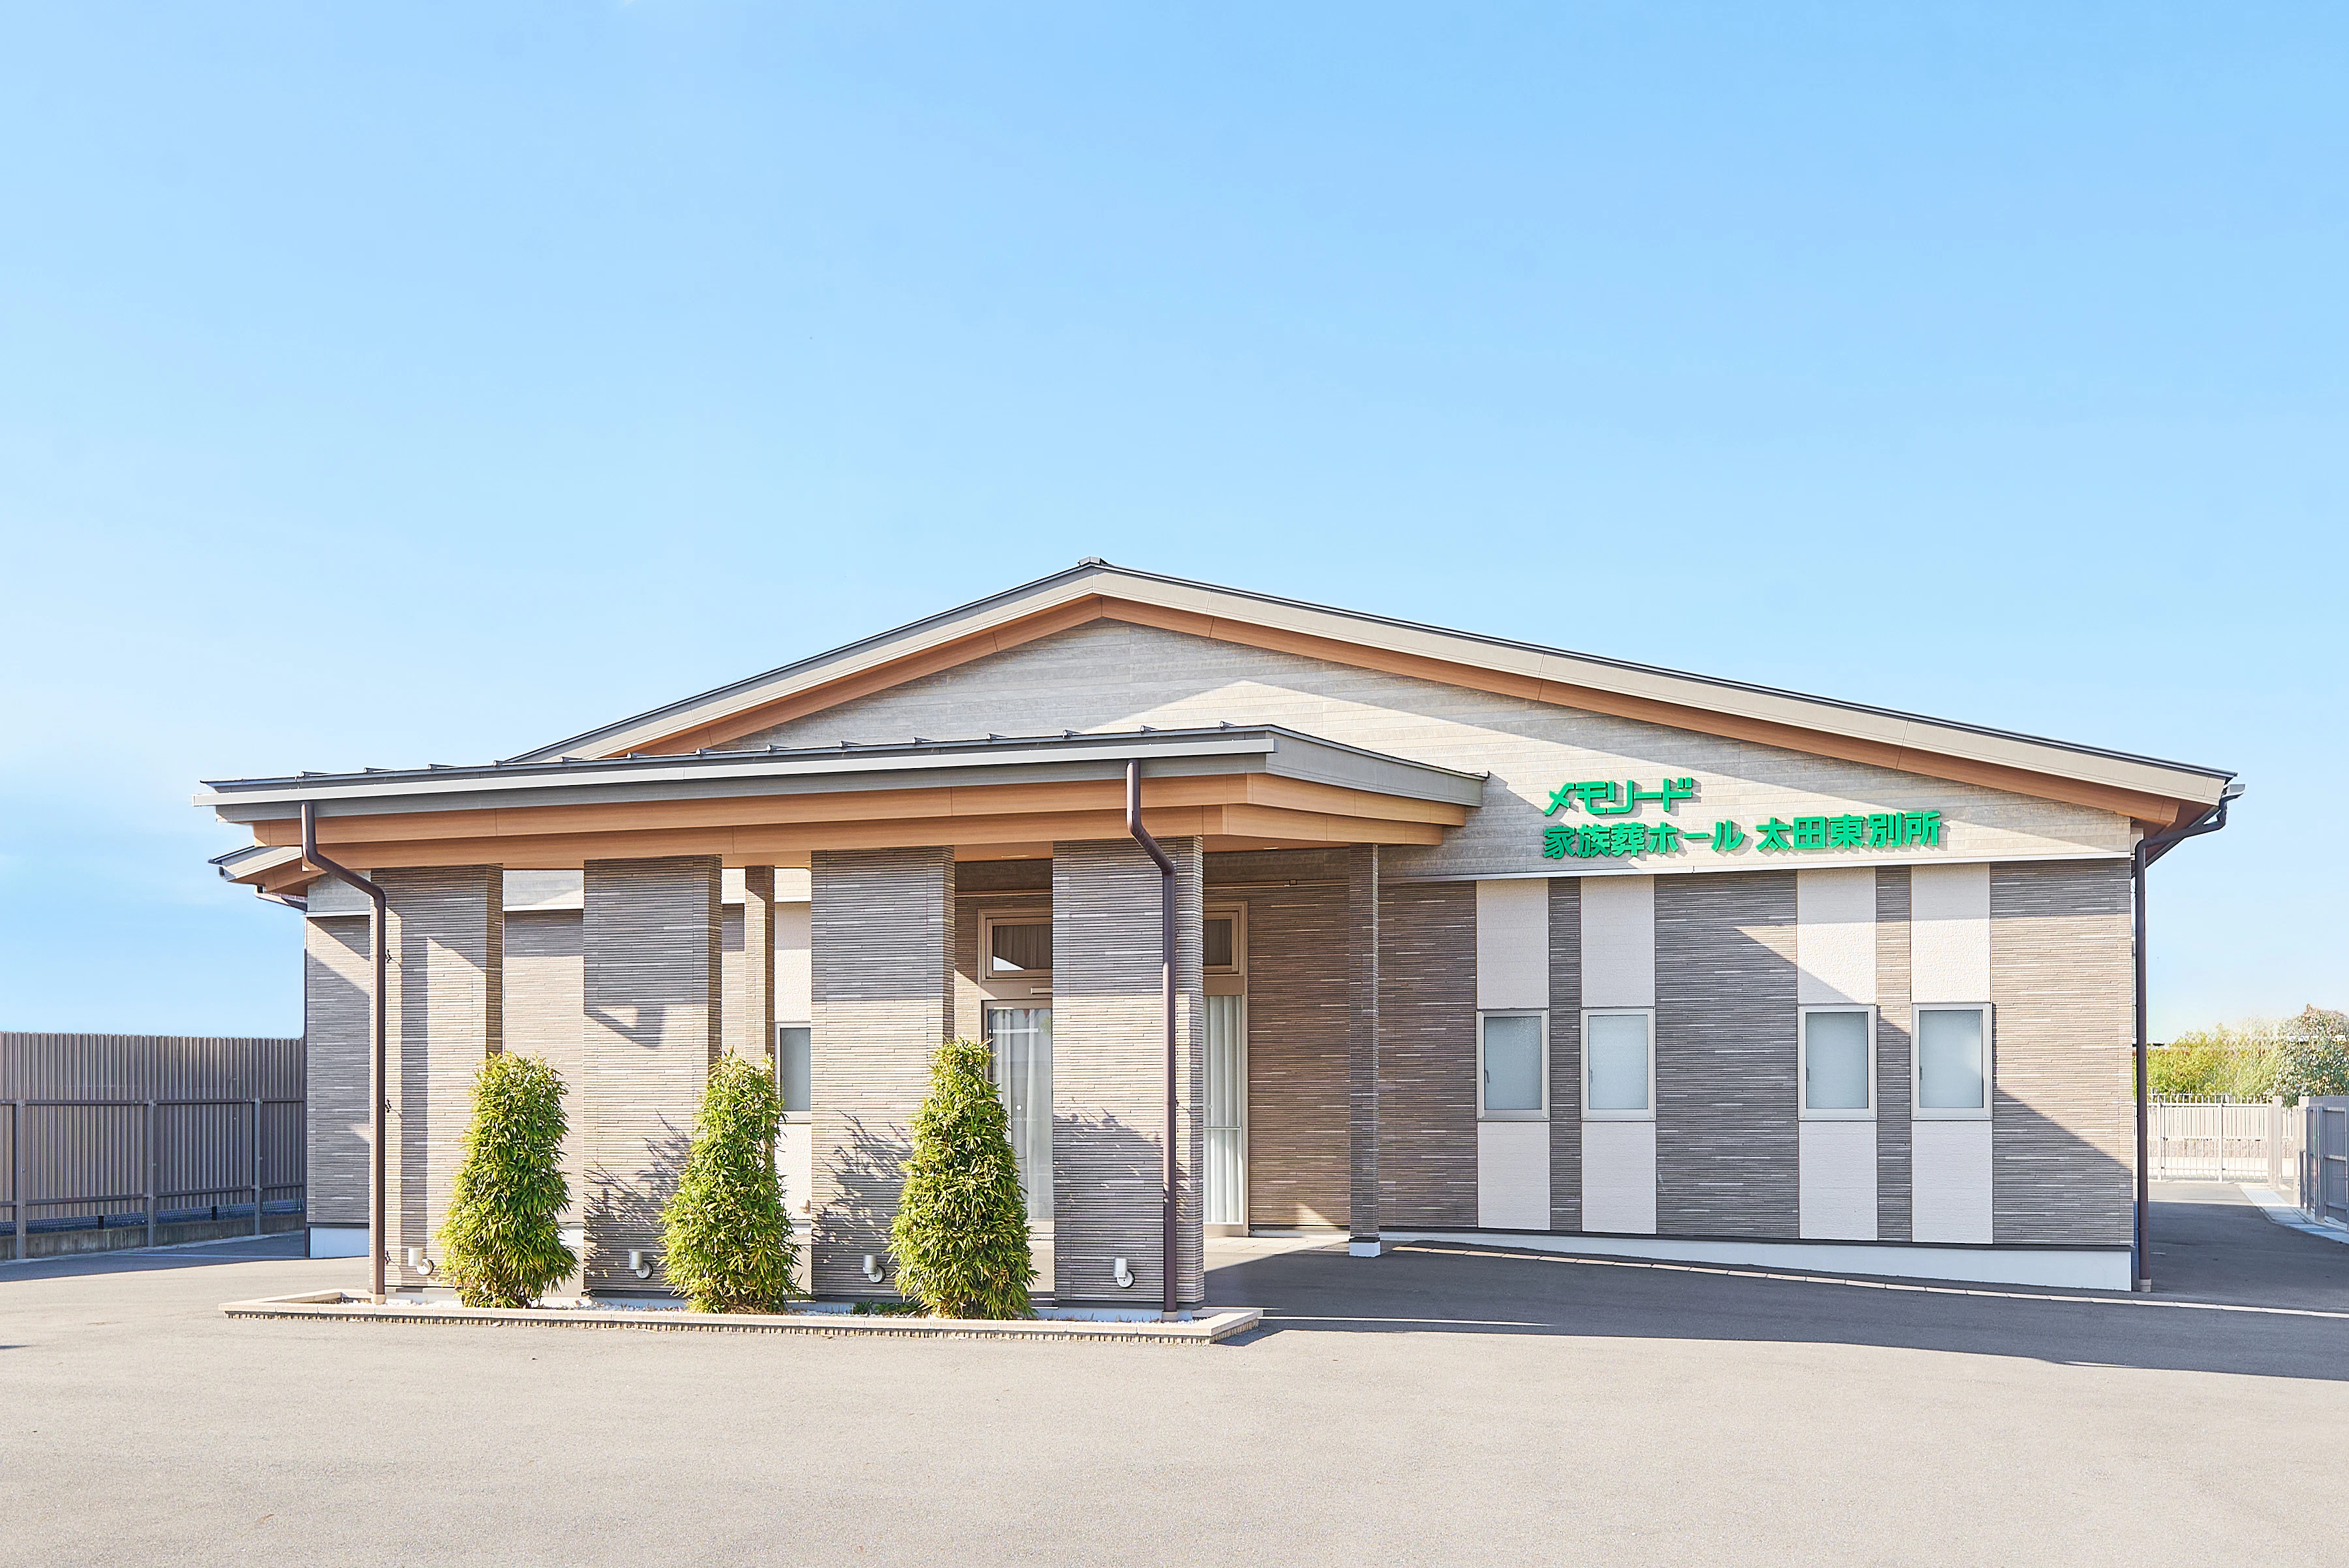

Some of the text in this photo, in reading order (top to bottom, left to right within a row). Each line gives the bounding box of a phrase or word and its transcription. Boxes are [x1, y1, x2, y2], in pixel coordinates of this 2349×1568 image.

[1544, 777, 1693, 816] メモリード
[1544, 810, 1942, 859] 家族葬ホール 太田東別所
